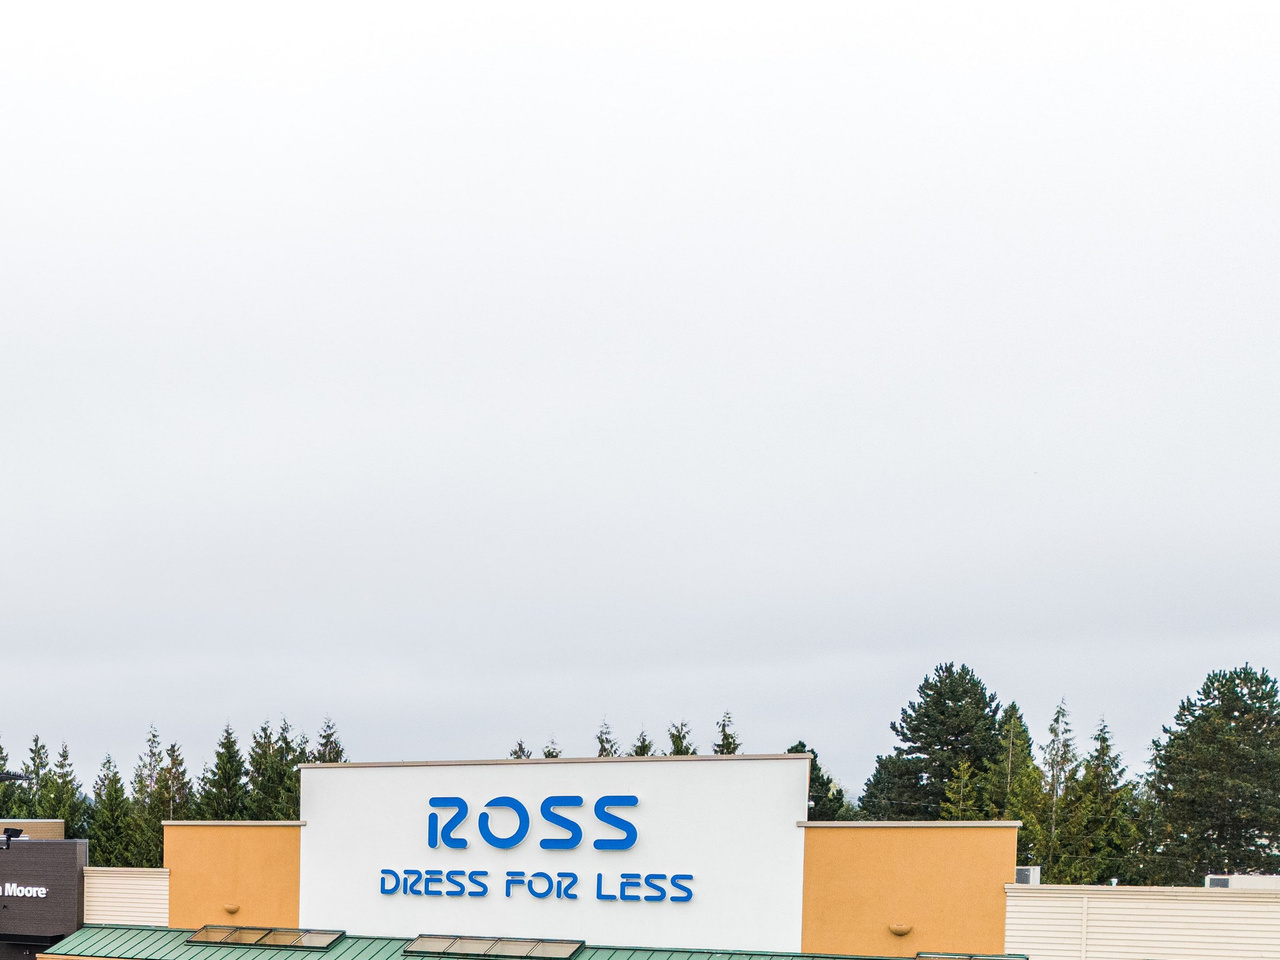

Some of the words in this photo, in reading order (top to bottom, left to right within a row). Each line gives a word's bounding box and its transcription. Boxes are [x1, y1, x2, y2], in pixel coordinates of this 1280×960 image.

[428, 795, 639, 850] ROSS
[5, 883, 47, 898] Moore
[380, 869, 490, 897] DRESS
[505, 871, 578, 899] FOR
[596, 872, 694, 902] LESS
